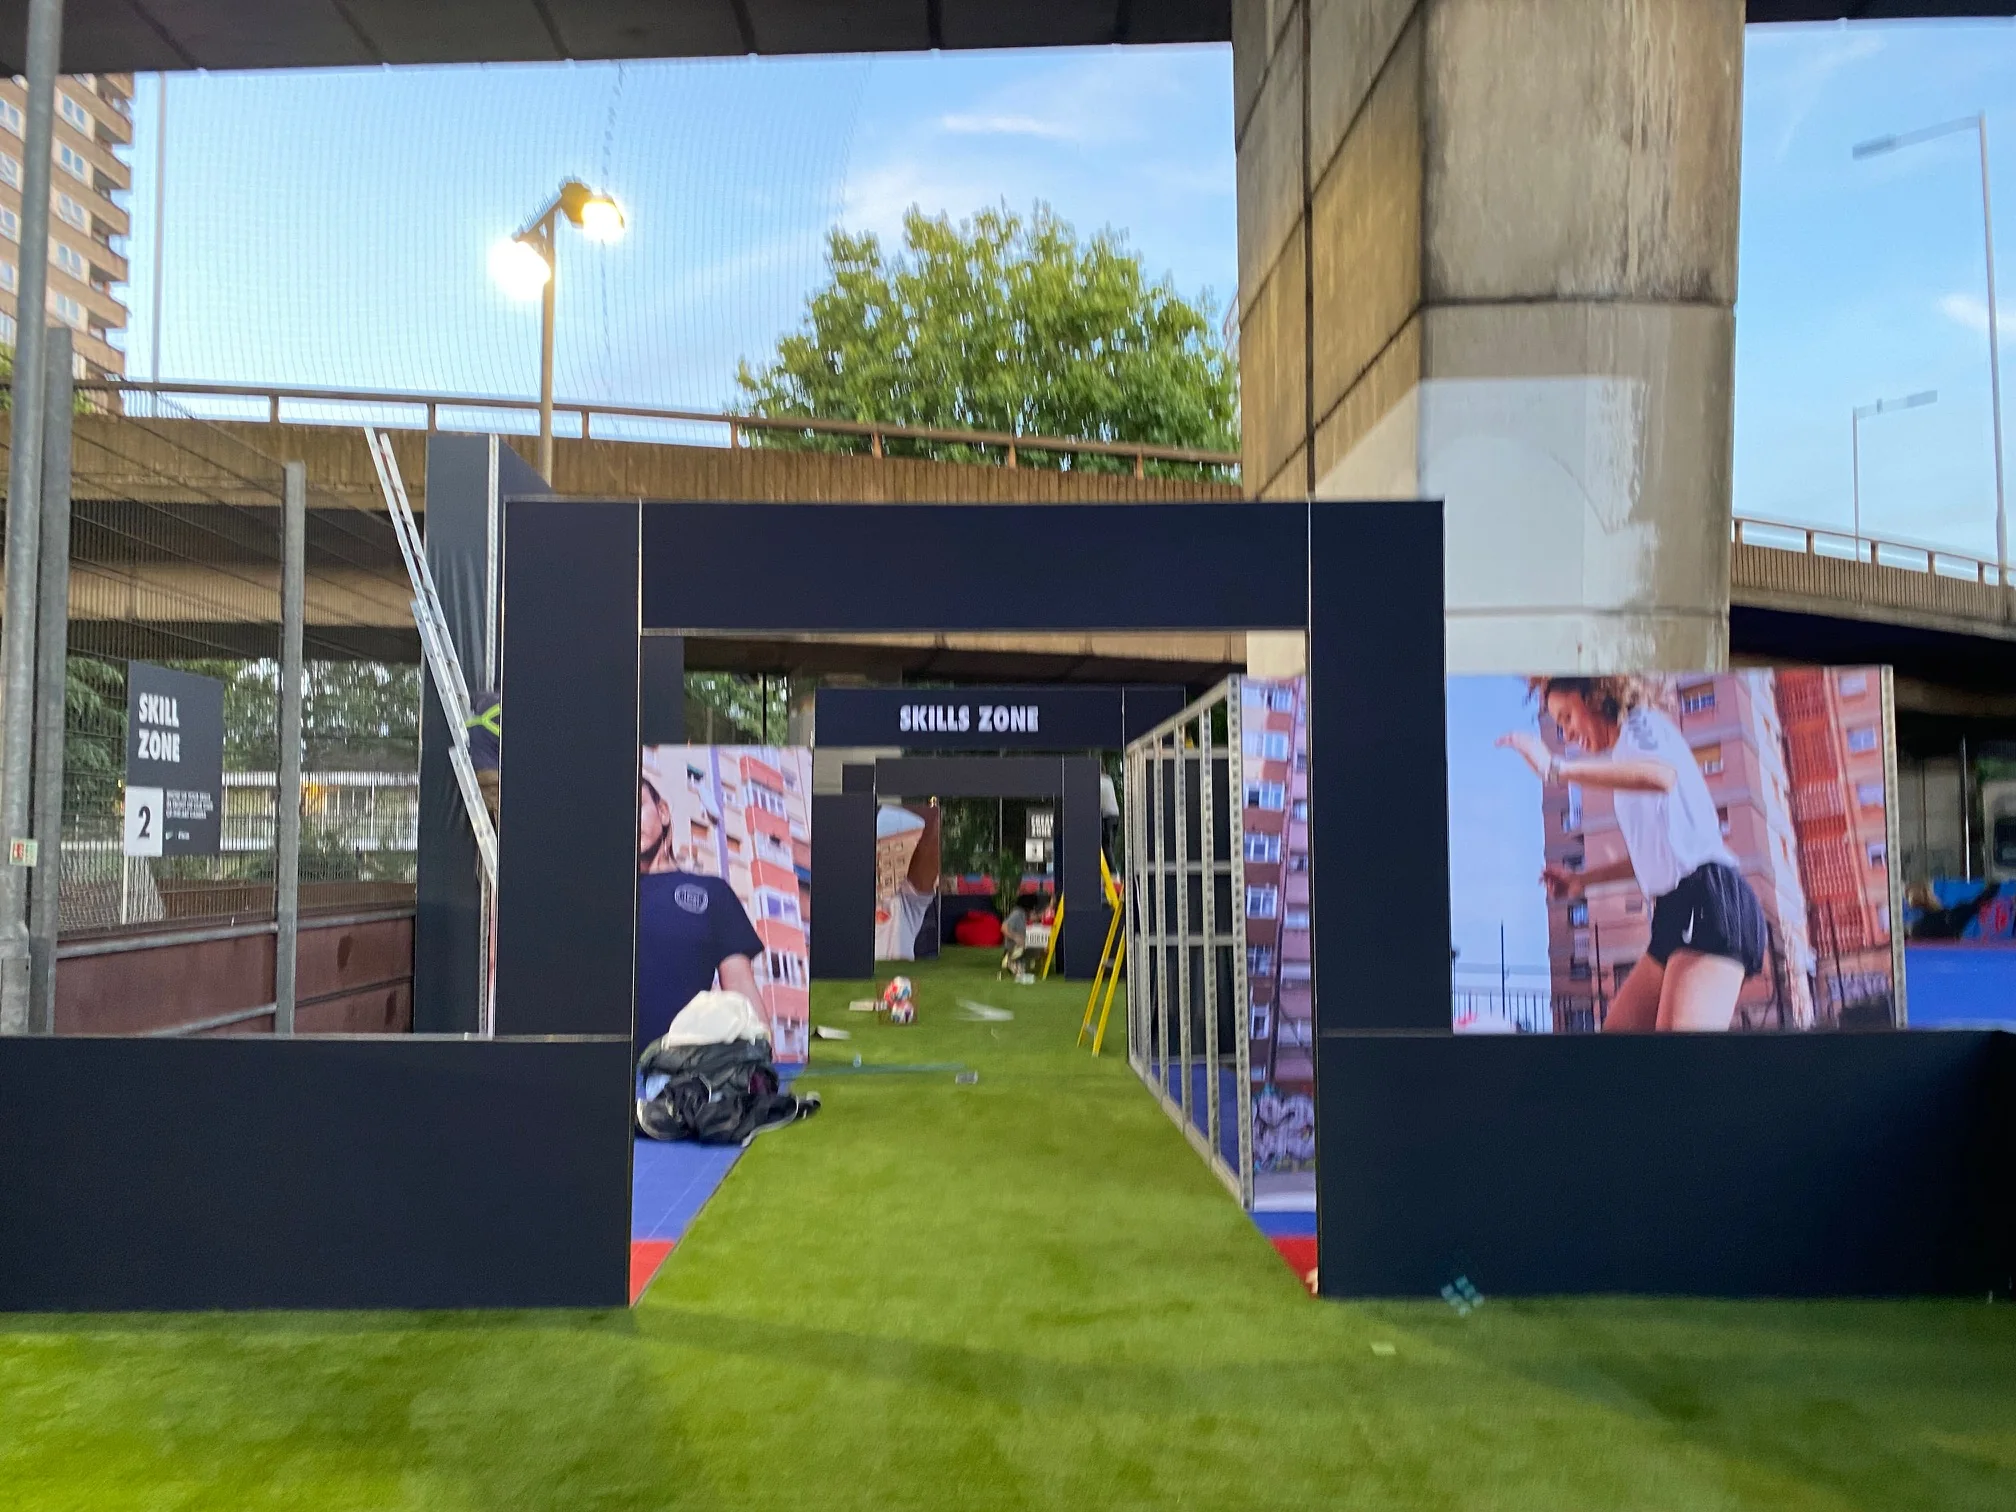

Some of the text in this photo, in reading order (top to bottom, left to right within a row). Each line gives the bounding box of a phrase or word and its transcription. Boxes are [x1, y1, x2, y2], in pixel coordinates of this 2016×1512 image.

[138, 692, 179, 728] SKILL
[900, 704, 1039, 732] SKILLS ZONE
[137, 728, 180, 763] ZONE
[137, 805, 151, 840] 2
